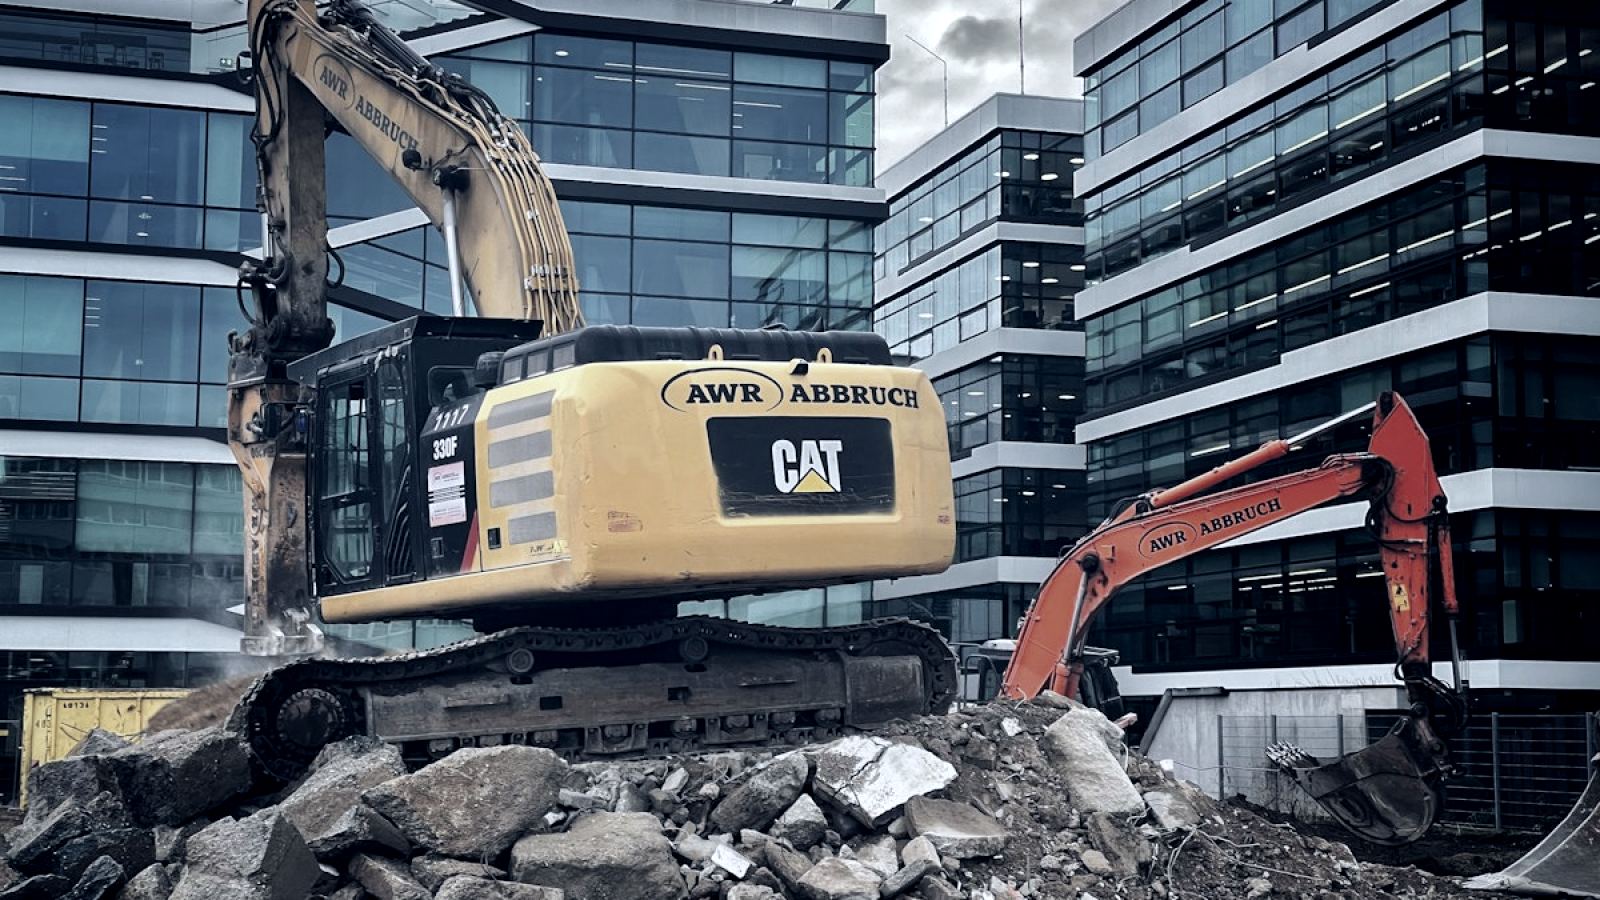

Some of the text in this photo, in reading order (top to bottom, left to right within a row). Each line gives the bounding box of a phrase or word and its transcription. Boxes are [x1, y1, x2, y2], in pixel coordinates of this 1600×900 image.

[320, 65, 419, 150] AWR ABBRUCH
[686, 383, 919, 409] AWR ABBRUCH
[433, 404, 469, 431] 1117
[432, 435, 458, 461] 330F
[771, 439, 843, 493] CAT
[1150, 498, 1281, 552] AWR ABBRUCH
